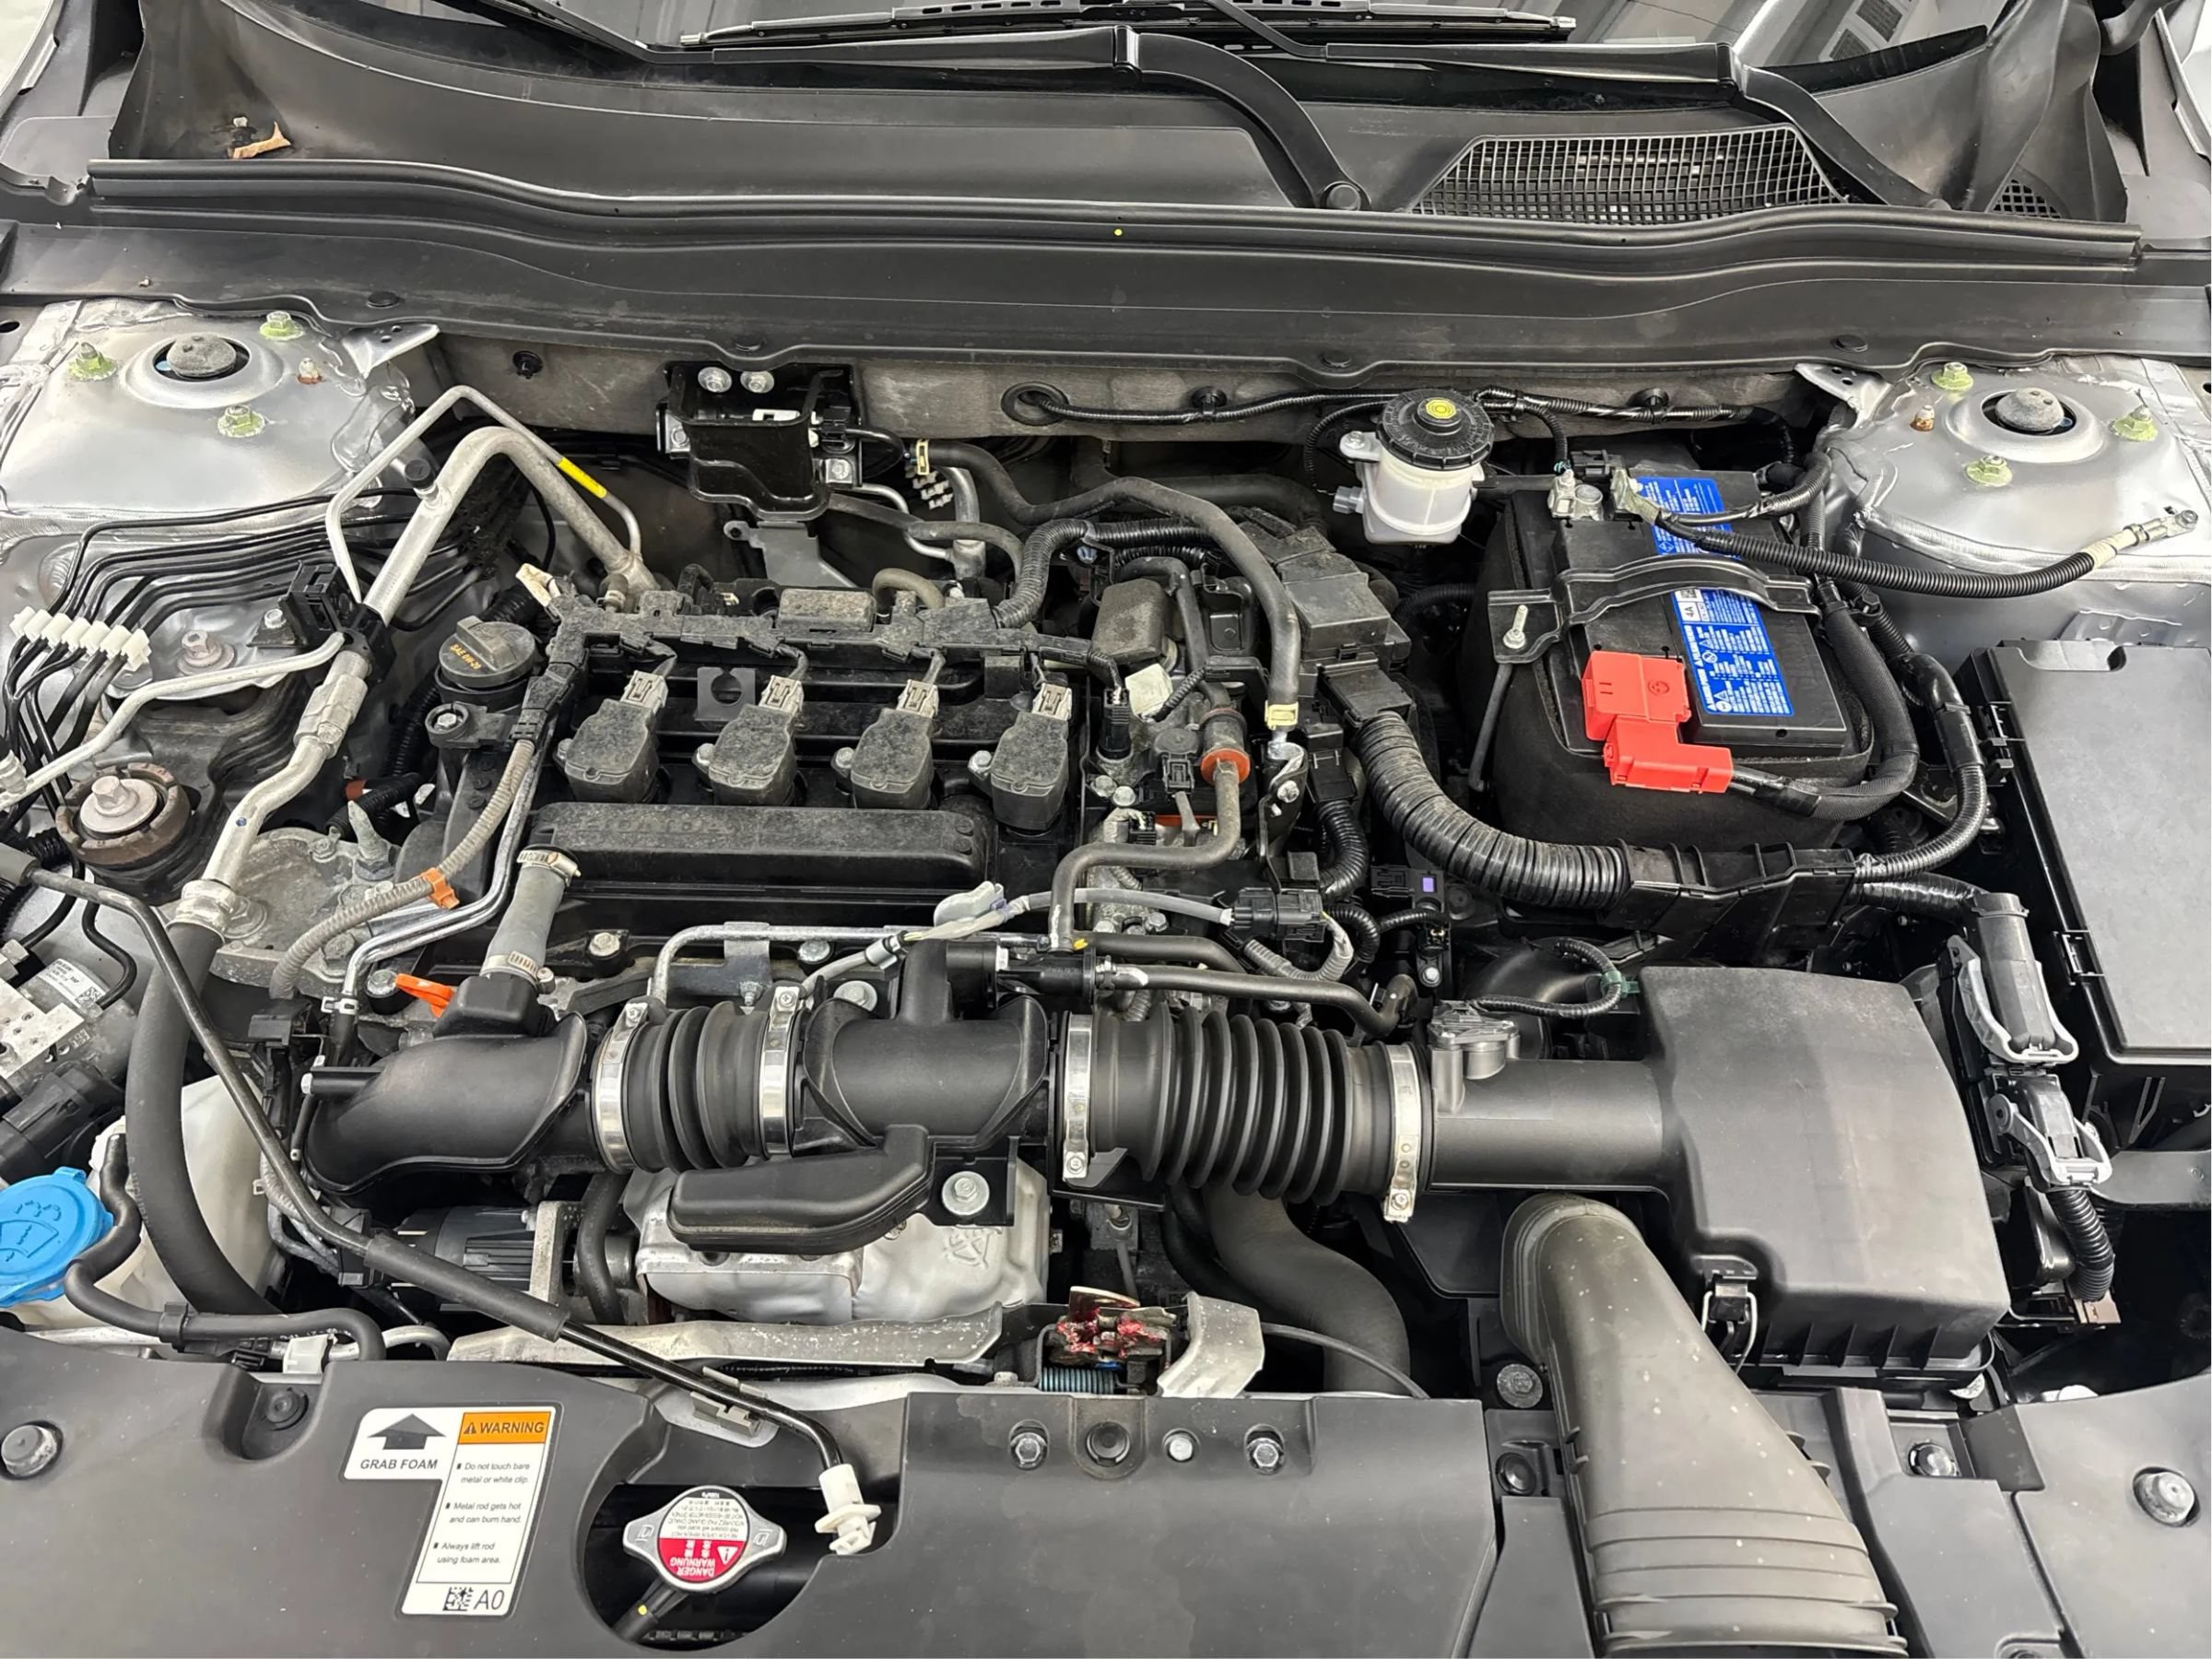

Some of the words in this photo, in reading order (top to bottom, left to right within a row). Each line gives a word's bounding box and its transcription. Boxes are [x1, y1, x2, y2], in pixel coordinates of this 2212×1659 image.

[450, 643, 466, 656] SAE
[479, 1421, 545, 1434] WARNING
[360, 1459, 397, 1469] GRAB
[400, 1459, 438, 1469] FOAM
[464, 1463, 476, 1471] Do
[491, 1463, 512, 1471] touch
[490, 1503, 506, 1512] gets
[441, 1543, 469, 1551] Always
[437, 1556, 458, 1565] using
[669, 1557, 716, 1569] WARNUNG
[677, 1567, 716, 1577] DANGER
